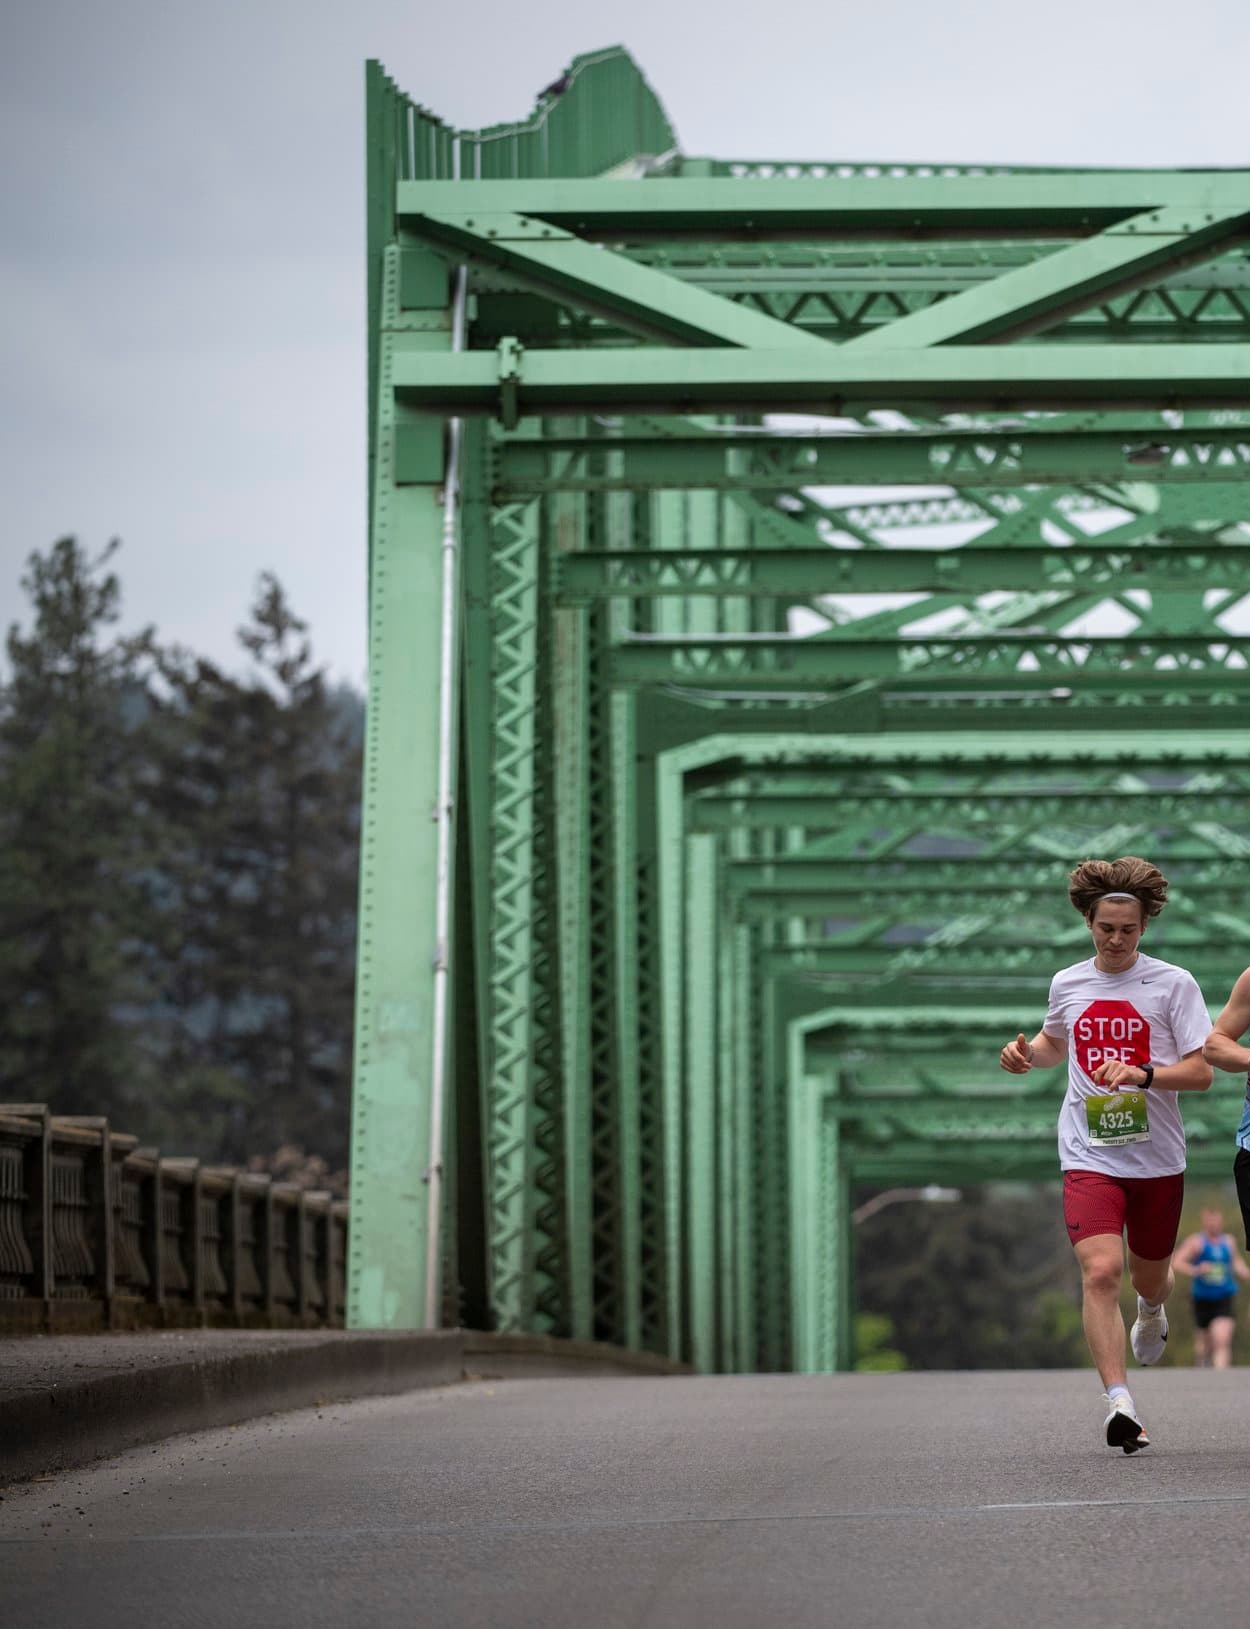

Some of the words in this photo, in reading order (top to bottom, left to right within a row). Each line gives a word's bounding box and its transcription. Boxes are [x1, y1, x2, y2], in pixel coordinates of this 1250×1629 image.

[1079, 1017, 1143, 1041] STOP
[1087, 1047, 1137, 1071] PRE
[1100, 1110, 1134, 1129] 4325
